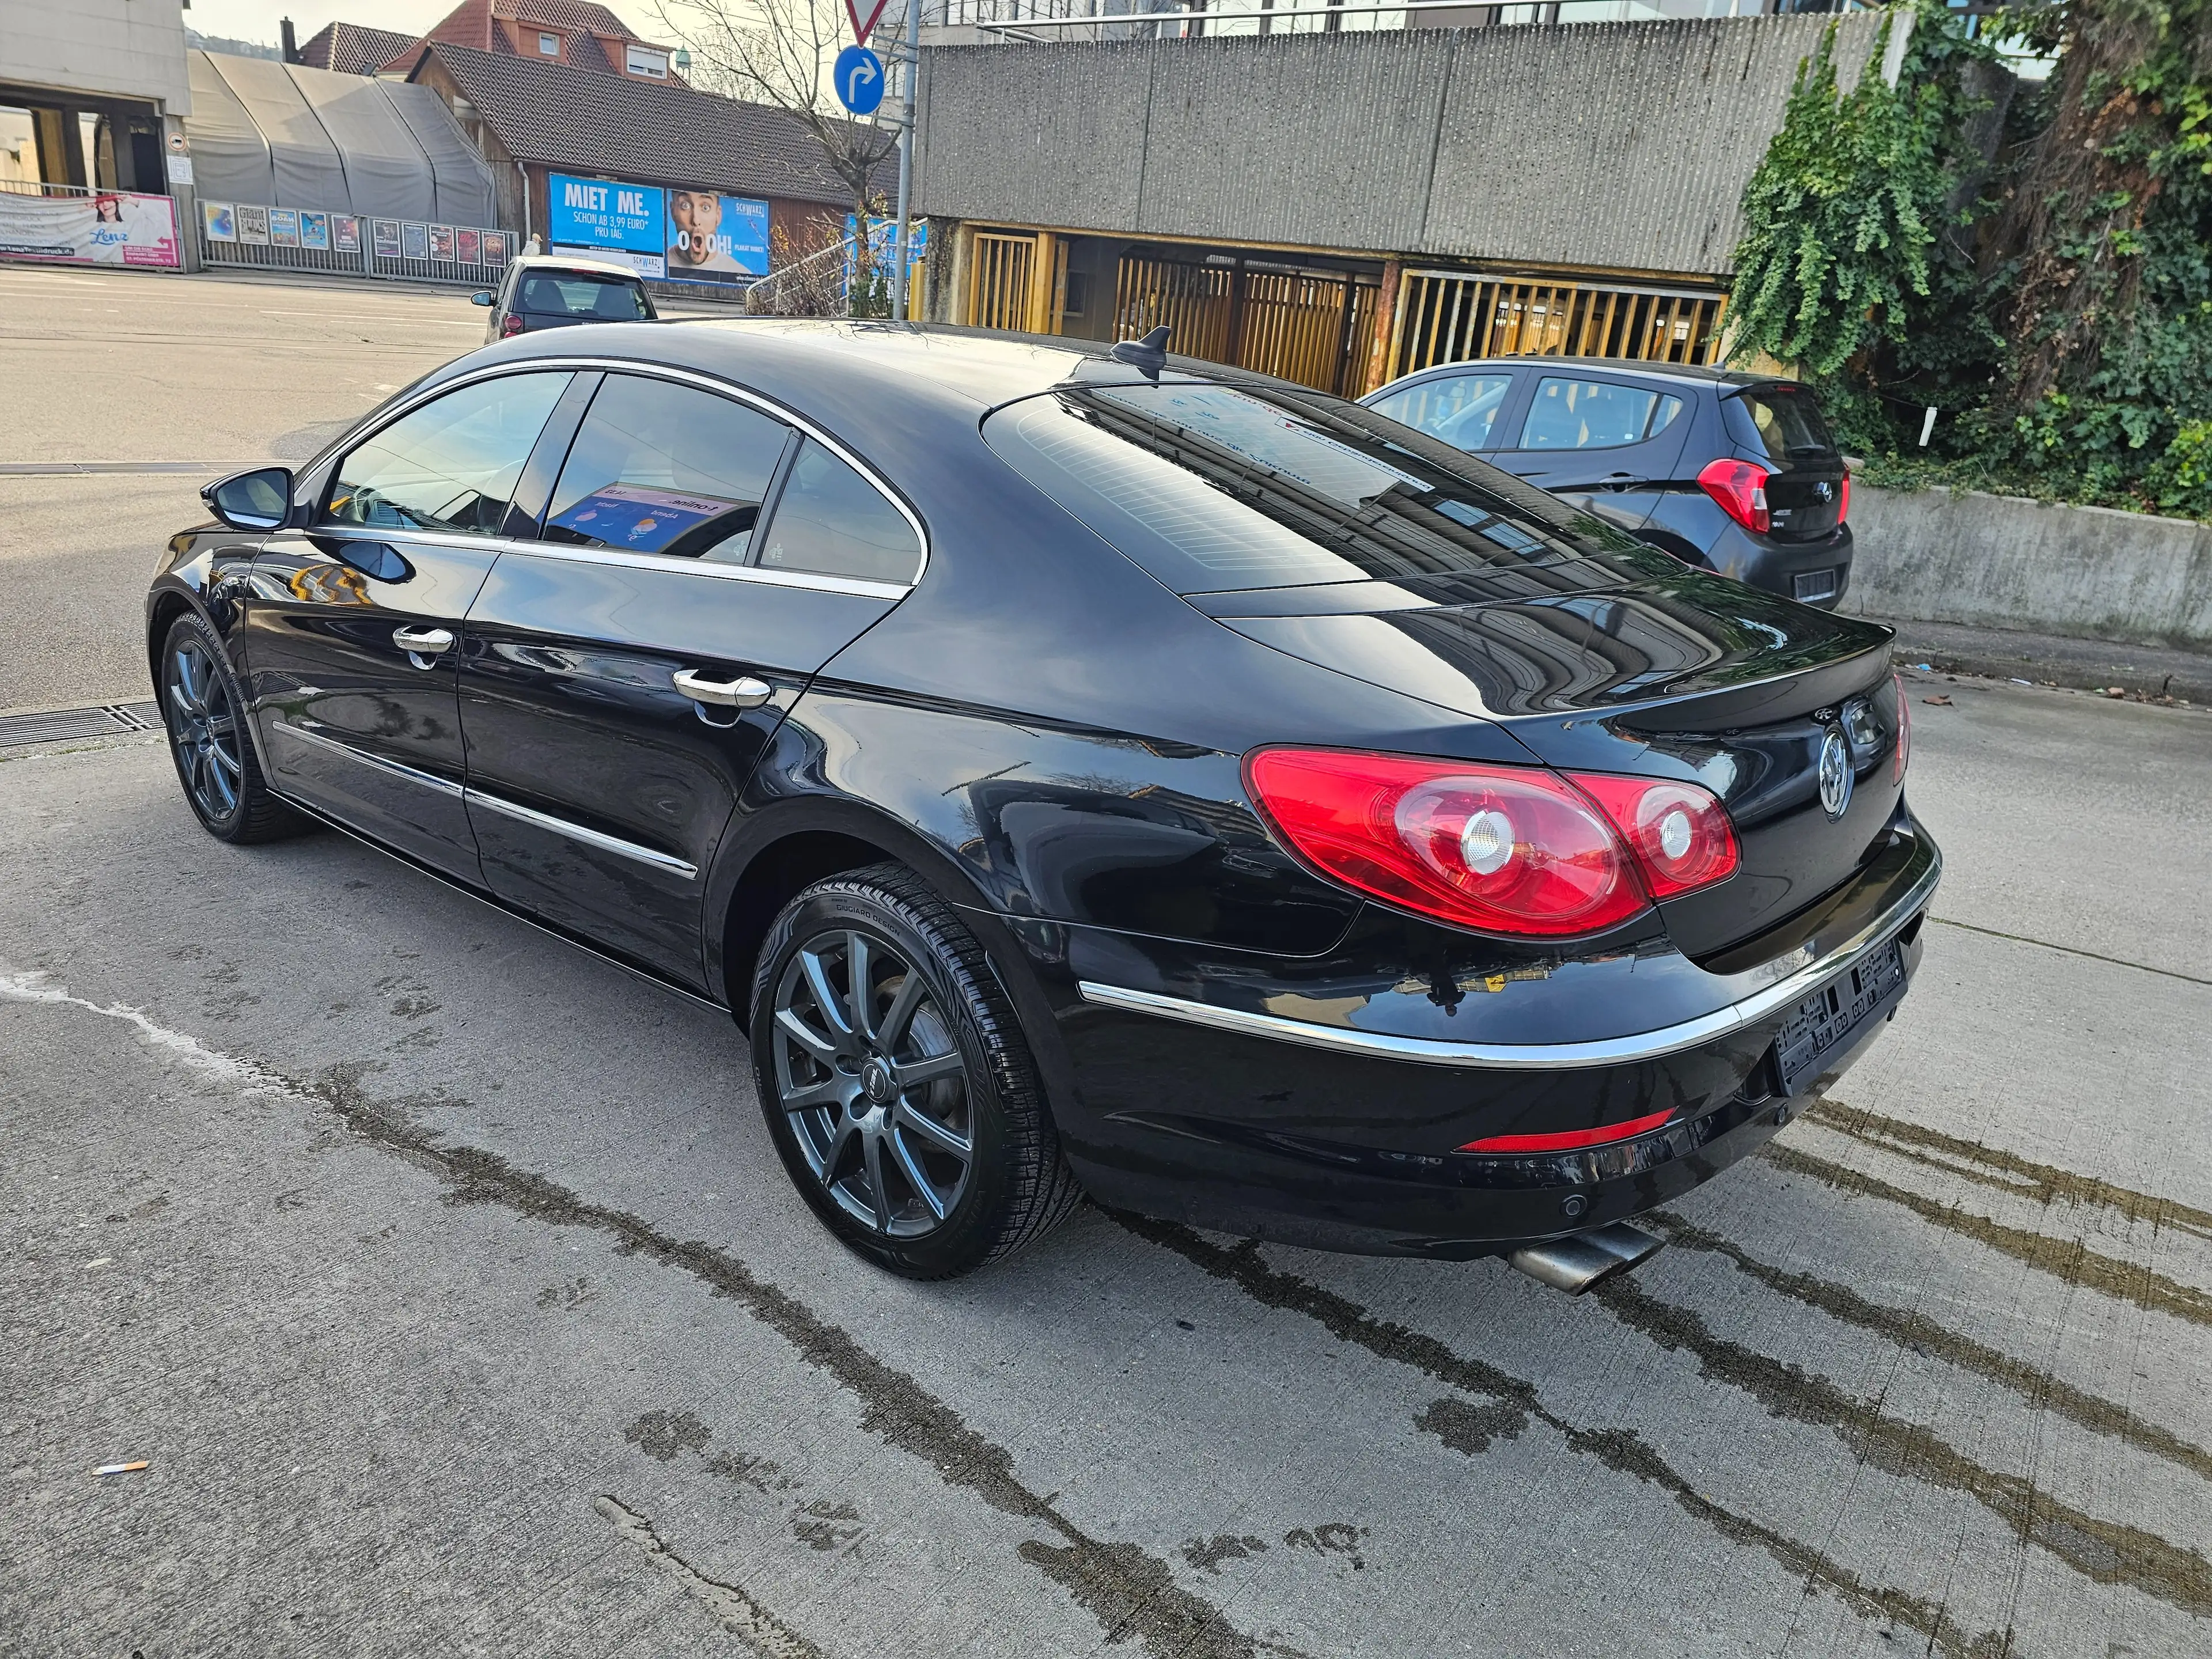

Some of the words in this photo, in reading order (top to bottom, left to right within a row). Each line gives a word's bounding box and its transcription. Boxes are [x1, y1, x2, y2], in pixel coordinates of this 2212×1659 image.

[565, 183, 608, 211] MIET
[618, 191, 650, 217] ME.
[573, 211, 597, 225] SCHON
[599, 215, 608, 226] AB
[609, 216, 626, 229] 3,99
[89, 228, 129, 245] Lenz
[594, 226, 608, 238] PRO
[611, 228, 624, 240] TAG.
[836, 904, 870, 919] GIUGIARO
[873, 915, 900, 937] DESIGN
